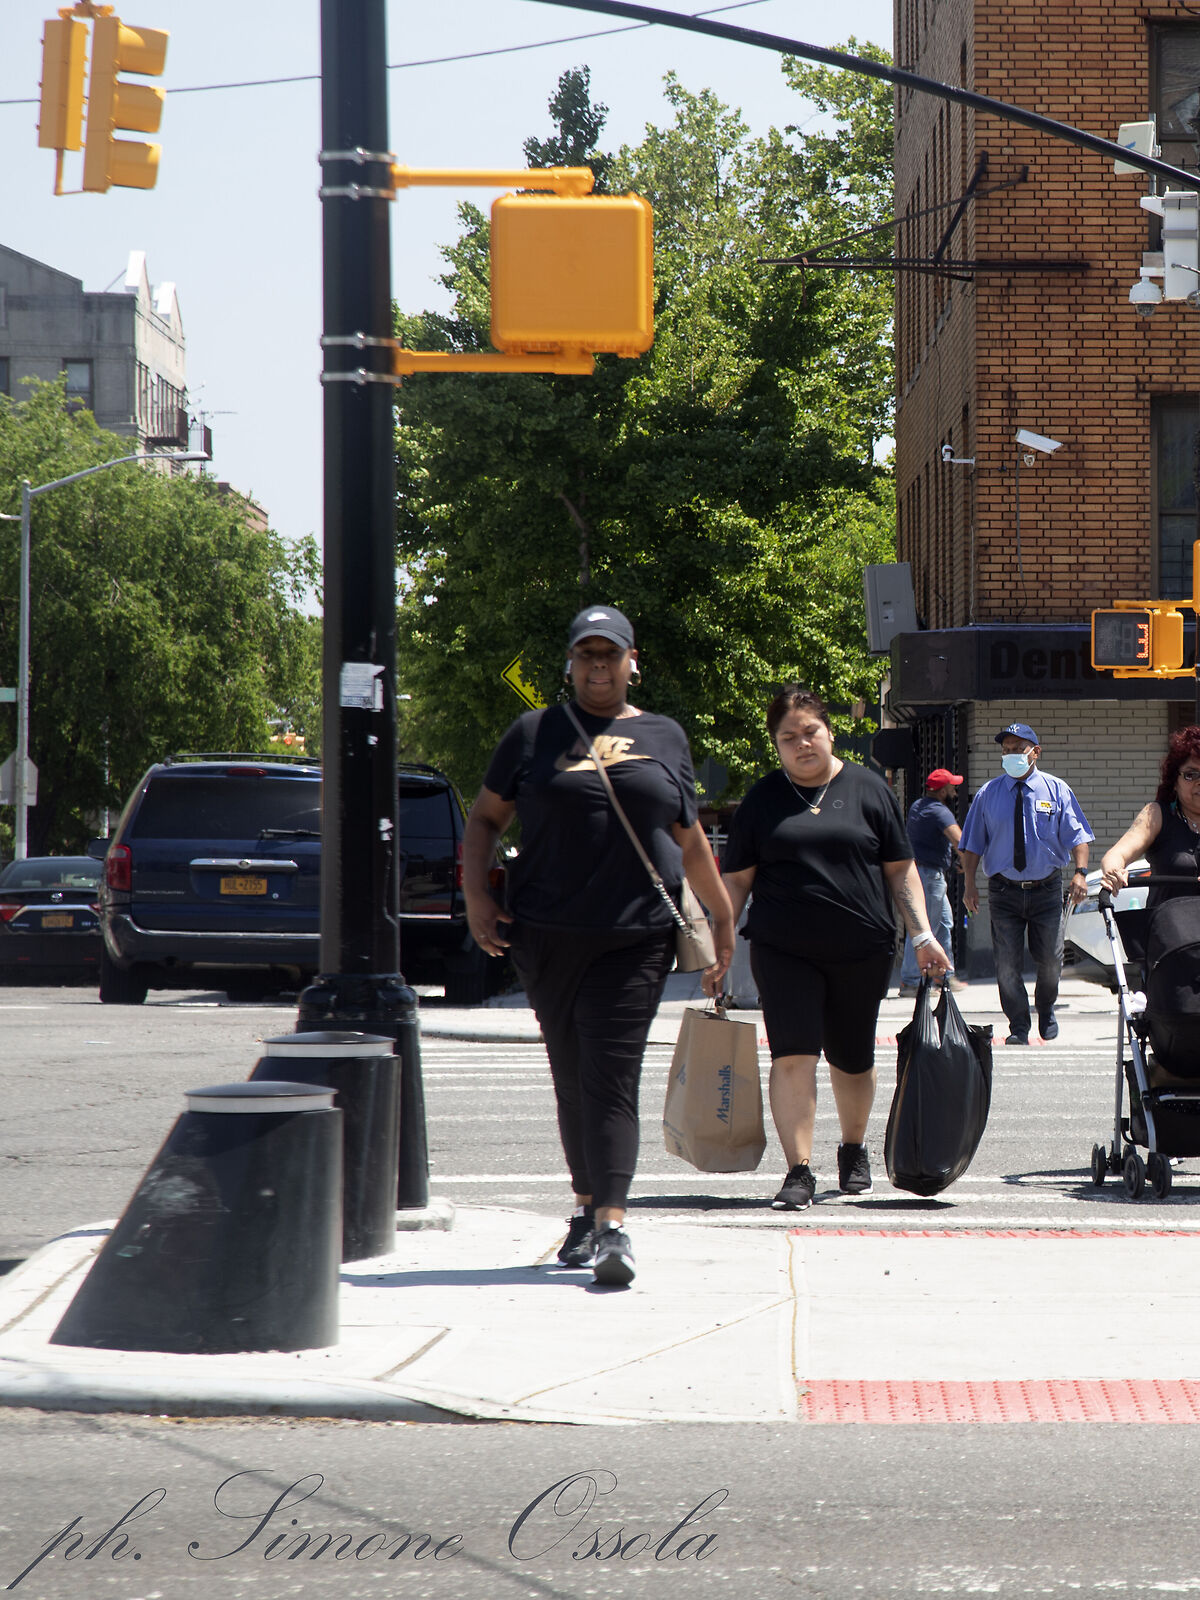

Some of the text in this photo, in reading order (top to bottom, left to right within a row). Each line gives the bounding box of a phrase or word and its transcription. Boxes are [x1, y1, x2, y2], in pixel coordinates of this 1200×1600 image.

[990, 640, 1099, 680] Dent
[1136, 623, 1149, 658] 3
[716, 1064, 732, 1125] Marshalls
